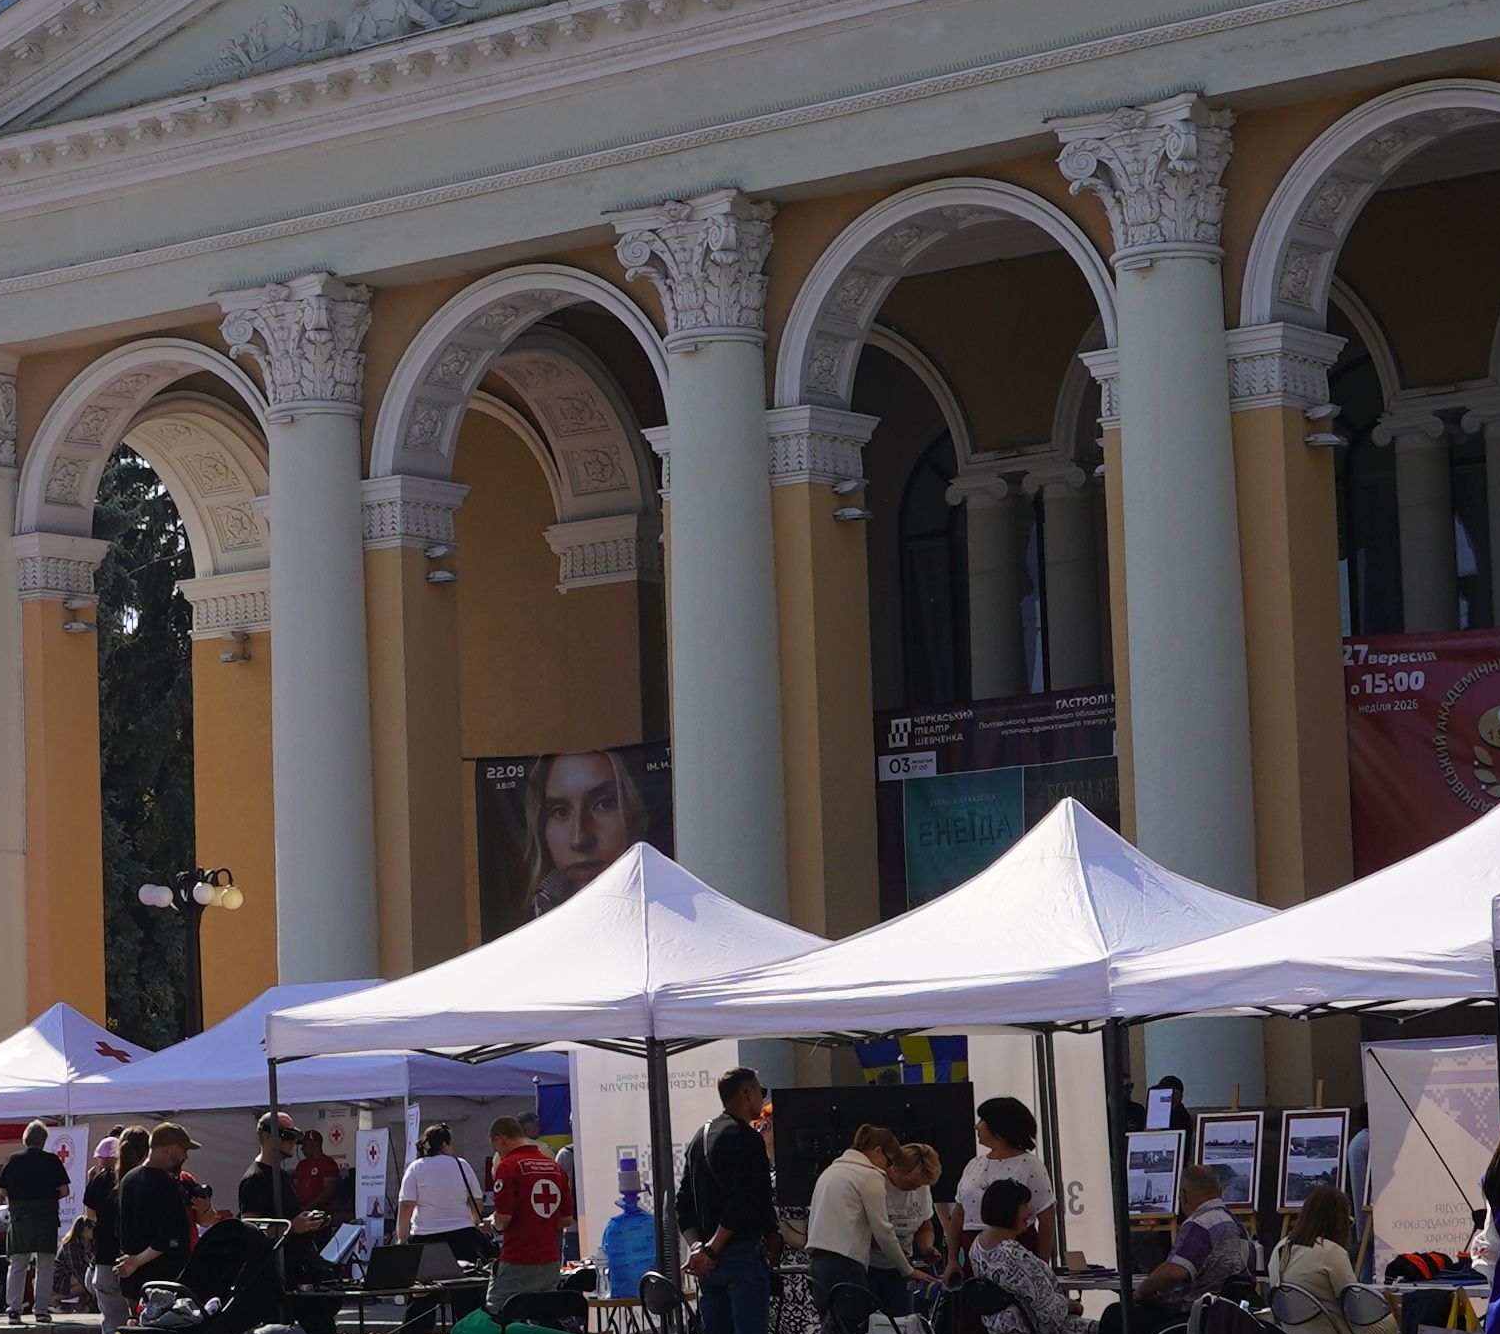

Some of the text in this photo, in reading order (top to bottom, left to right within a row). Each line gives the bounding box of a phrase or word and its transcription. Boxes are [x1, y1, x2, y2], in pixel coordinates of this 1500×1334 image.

[1368, 649, 1437, 667] вересня
[1362, 670, 1425, 694] 15:00
[889, 757, 911, 774] 03
[1431, 737, 1497, 812] АРКІВСЬКИЙ
